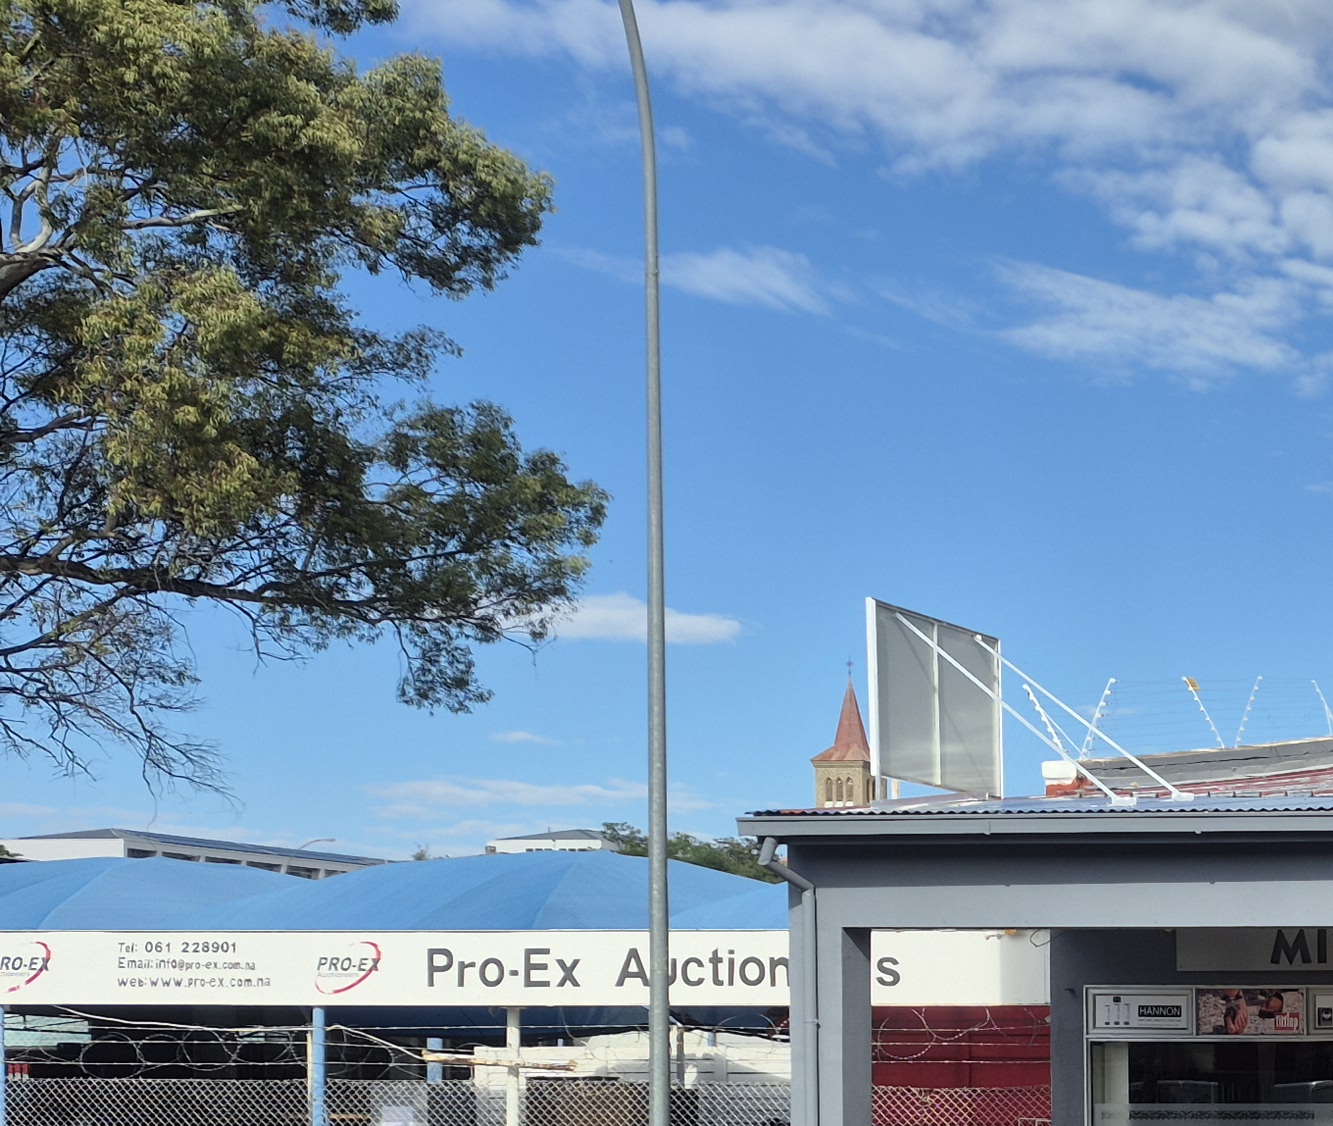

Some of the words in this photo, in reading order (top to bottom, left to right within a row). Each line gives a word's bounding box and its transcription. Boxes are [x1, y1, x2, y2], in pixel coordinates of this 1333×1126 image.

[118, 942, 138, 953] Tel:
[145, 942, 171, 953] 061
[181, 942, 237, 953] 228901
[0, 956, 49, 971] RO-EX
[317, 957, 379, 971] PRO-EX
[426, 948, 581, 988] Pro-Ex
[1139, 1006, 1181, 1016] HANNON
